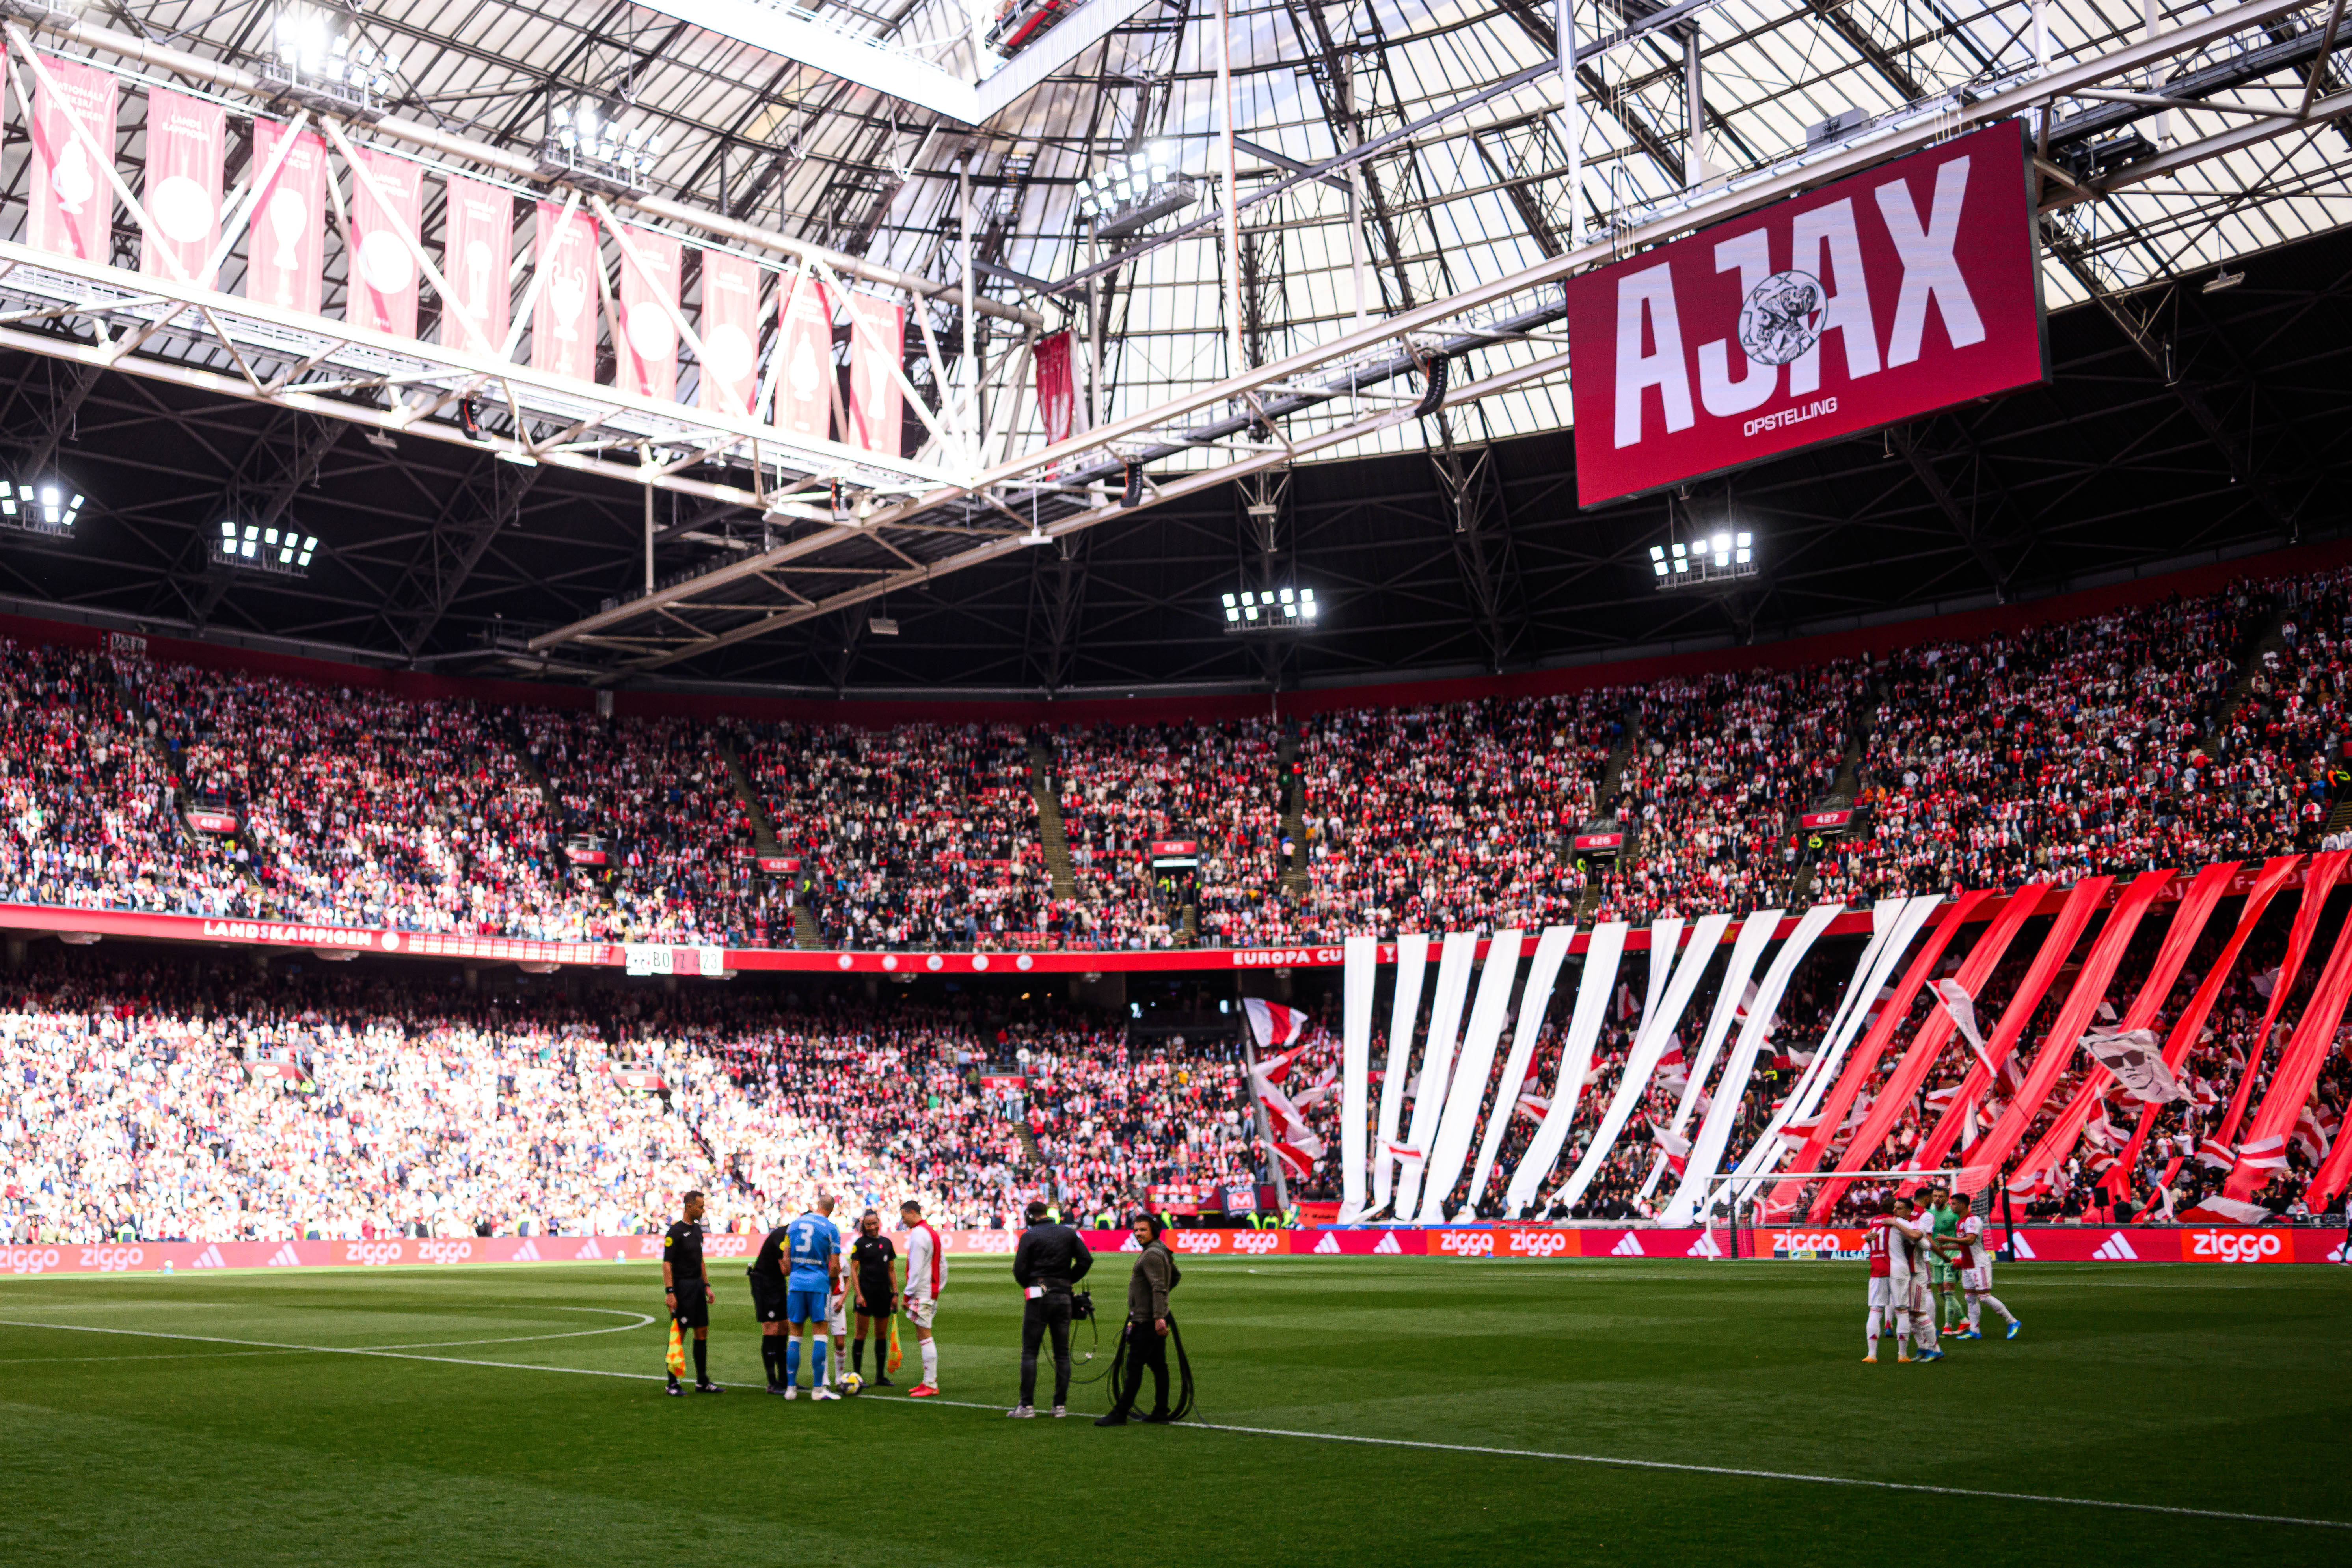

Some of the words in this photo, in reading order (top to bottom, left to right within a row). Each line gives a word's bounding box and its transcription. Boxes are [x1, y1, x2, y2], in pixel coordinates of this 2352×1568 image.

[1615, 155, 1986, 450] AJAX
[1743, 396, 1838, 437] OPSTELLING
[1816, 813, 1839, 824] 427
[203, 920, 372, 946] LANDSKAMPIOEN
[1233, 950, 1311, 965] EUROPA
[1317, 948, 1343, 962] CU
[795, 1223, 813, 1252] 3
[1177, 1229, 1221, 1254] ziggo
[1233, 1229, 1278, 1254] ziggo
[1440, 1229, 1494, 1256] ziggo
[1509, 1229, 1566, 1257] ziggo
[2192, 1228, 2281, 1262] ziggo
[80, 1242, 144, 1272] ziggo
[346, 1240, 402, 1266] ziggo
[418, 1238, 472, 1264] ziggo
